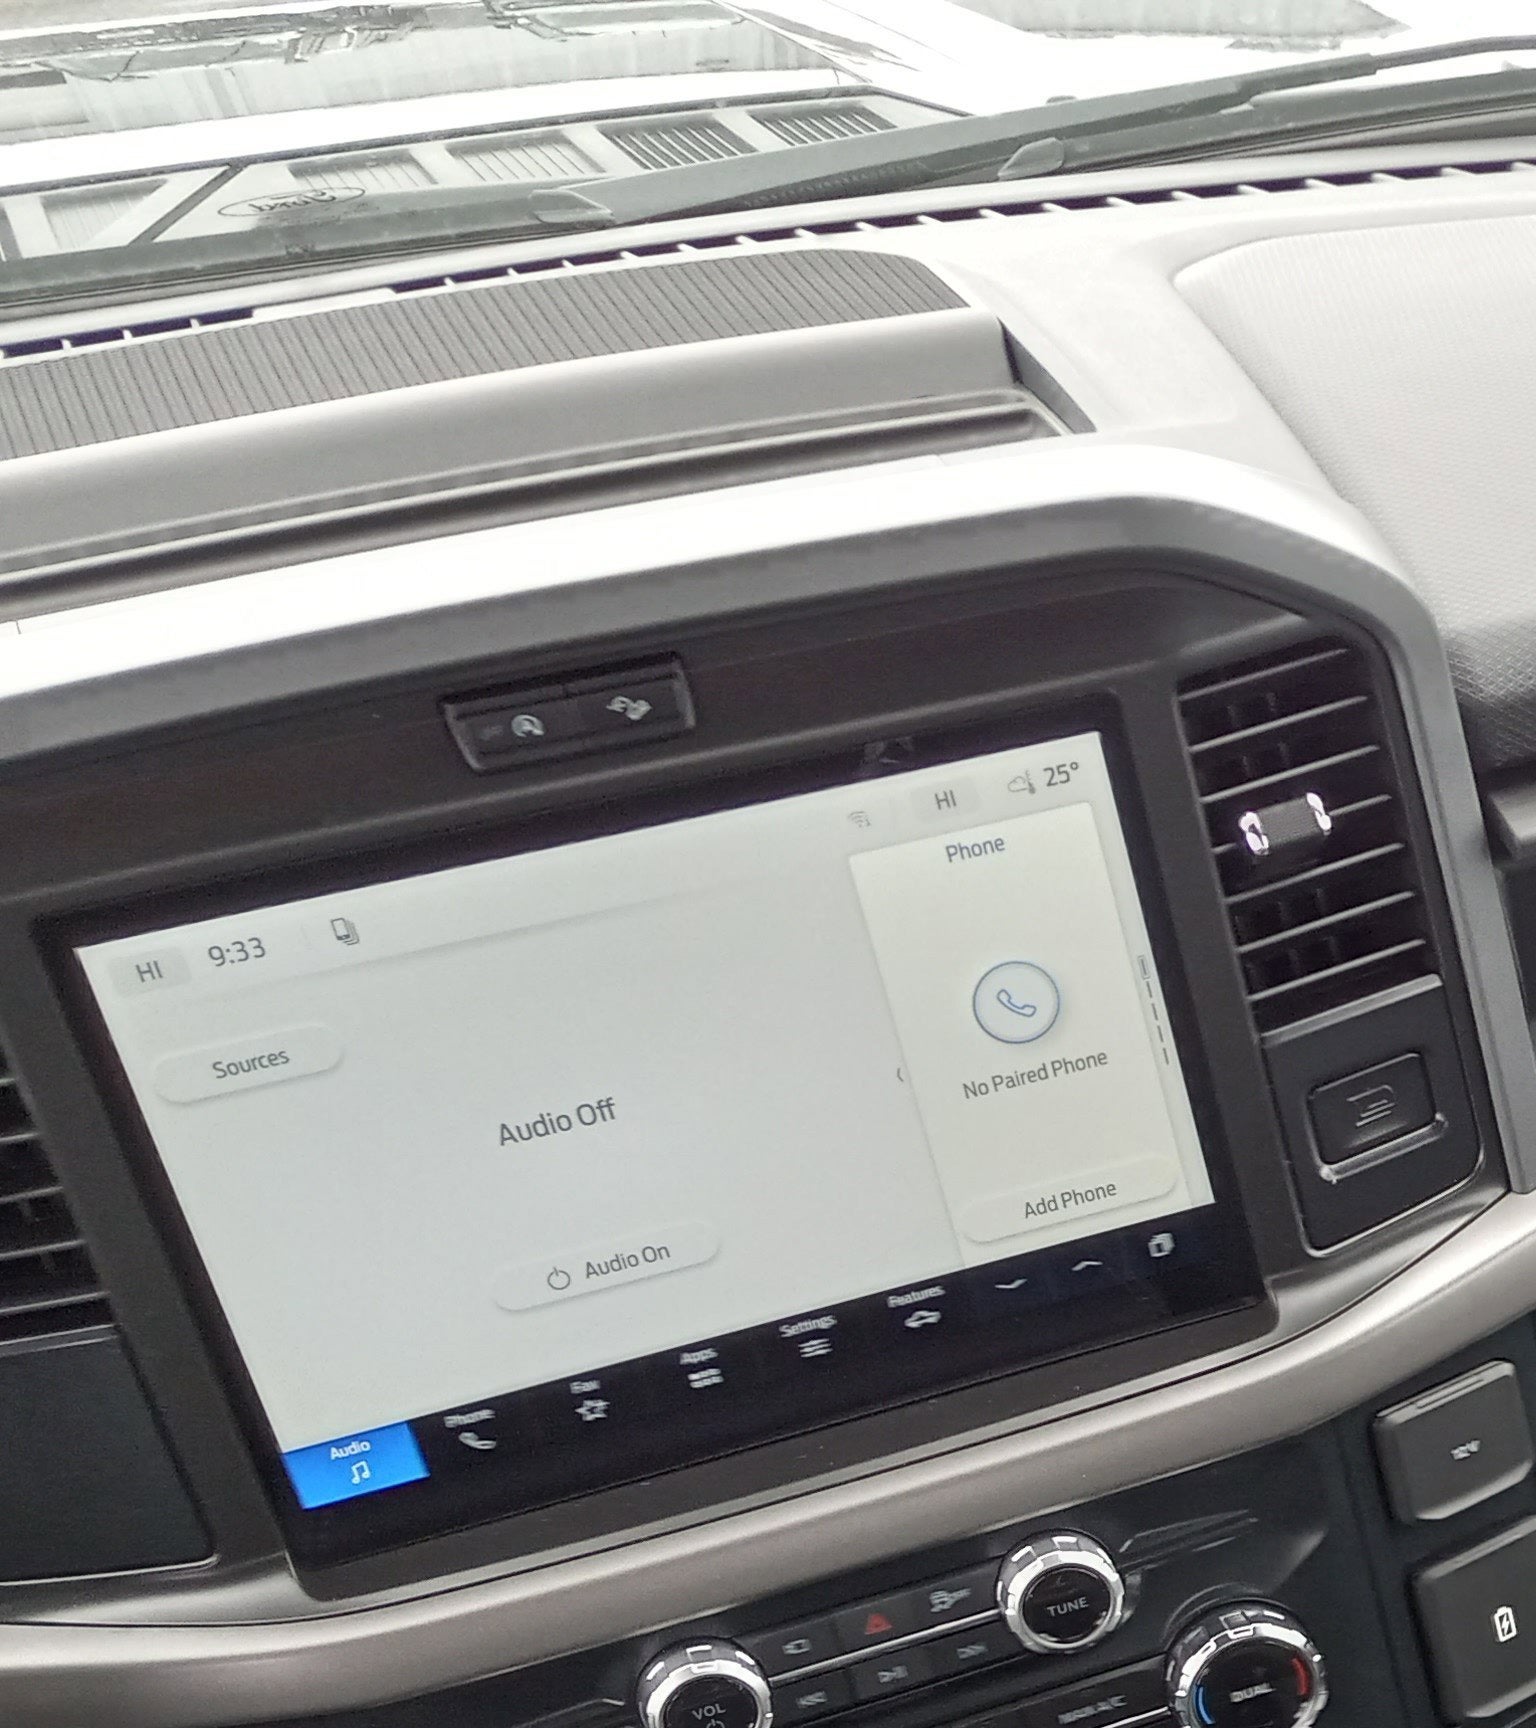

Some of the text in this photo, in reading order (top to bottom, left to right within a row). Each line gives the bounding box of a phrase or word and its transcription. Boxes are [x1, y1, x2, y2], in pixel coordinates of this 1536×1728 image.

[1044, 760, 1081, 788] 25°
[935, 789, 958, 813] HI
[945, 834, 1007, 863] Phone
[207, 936, 267, 968] 9:33
[136, 959, 164, 984] HI
[212, 1047, 291, 1081] Sources
[962, 1050, 1109, 1100] No Paired Phone
[498, 1097, 618, 1147] Audio Off
[1023, 1181, 1117, 1220] Add Phone
[584, 1242, 671, 1280] Audio On
[887, 1284, 946, 1309] Features
[778, 1314, 838, 1339] Settings
[330, 1438, 372, 1461] Audio
[1046, 1596, 1090, 1617] TUNE
[691, 1703, 727, 1720] VOL
